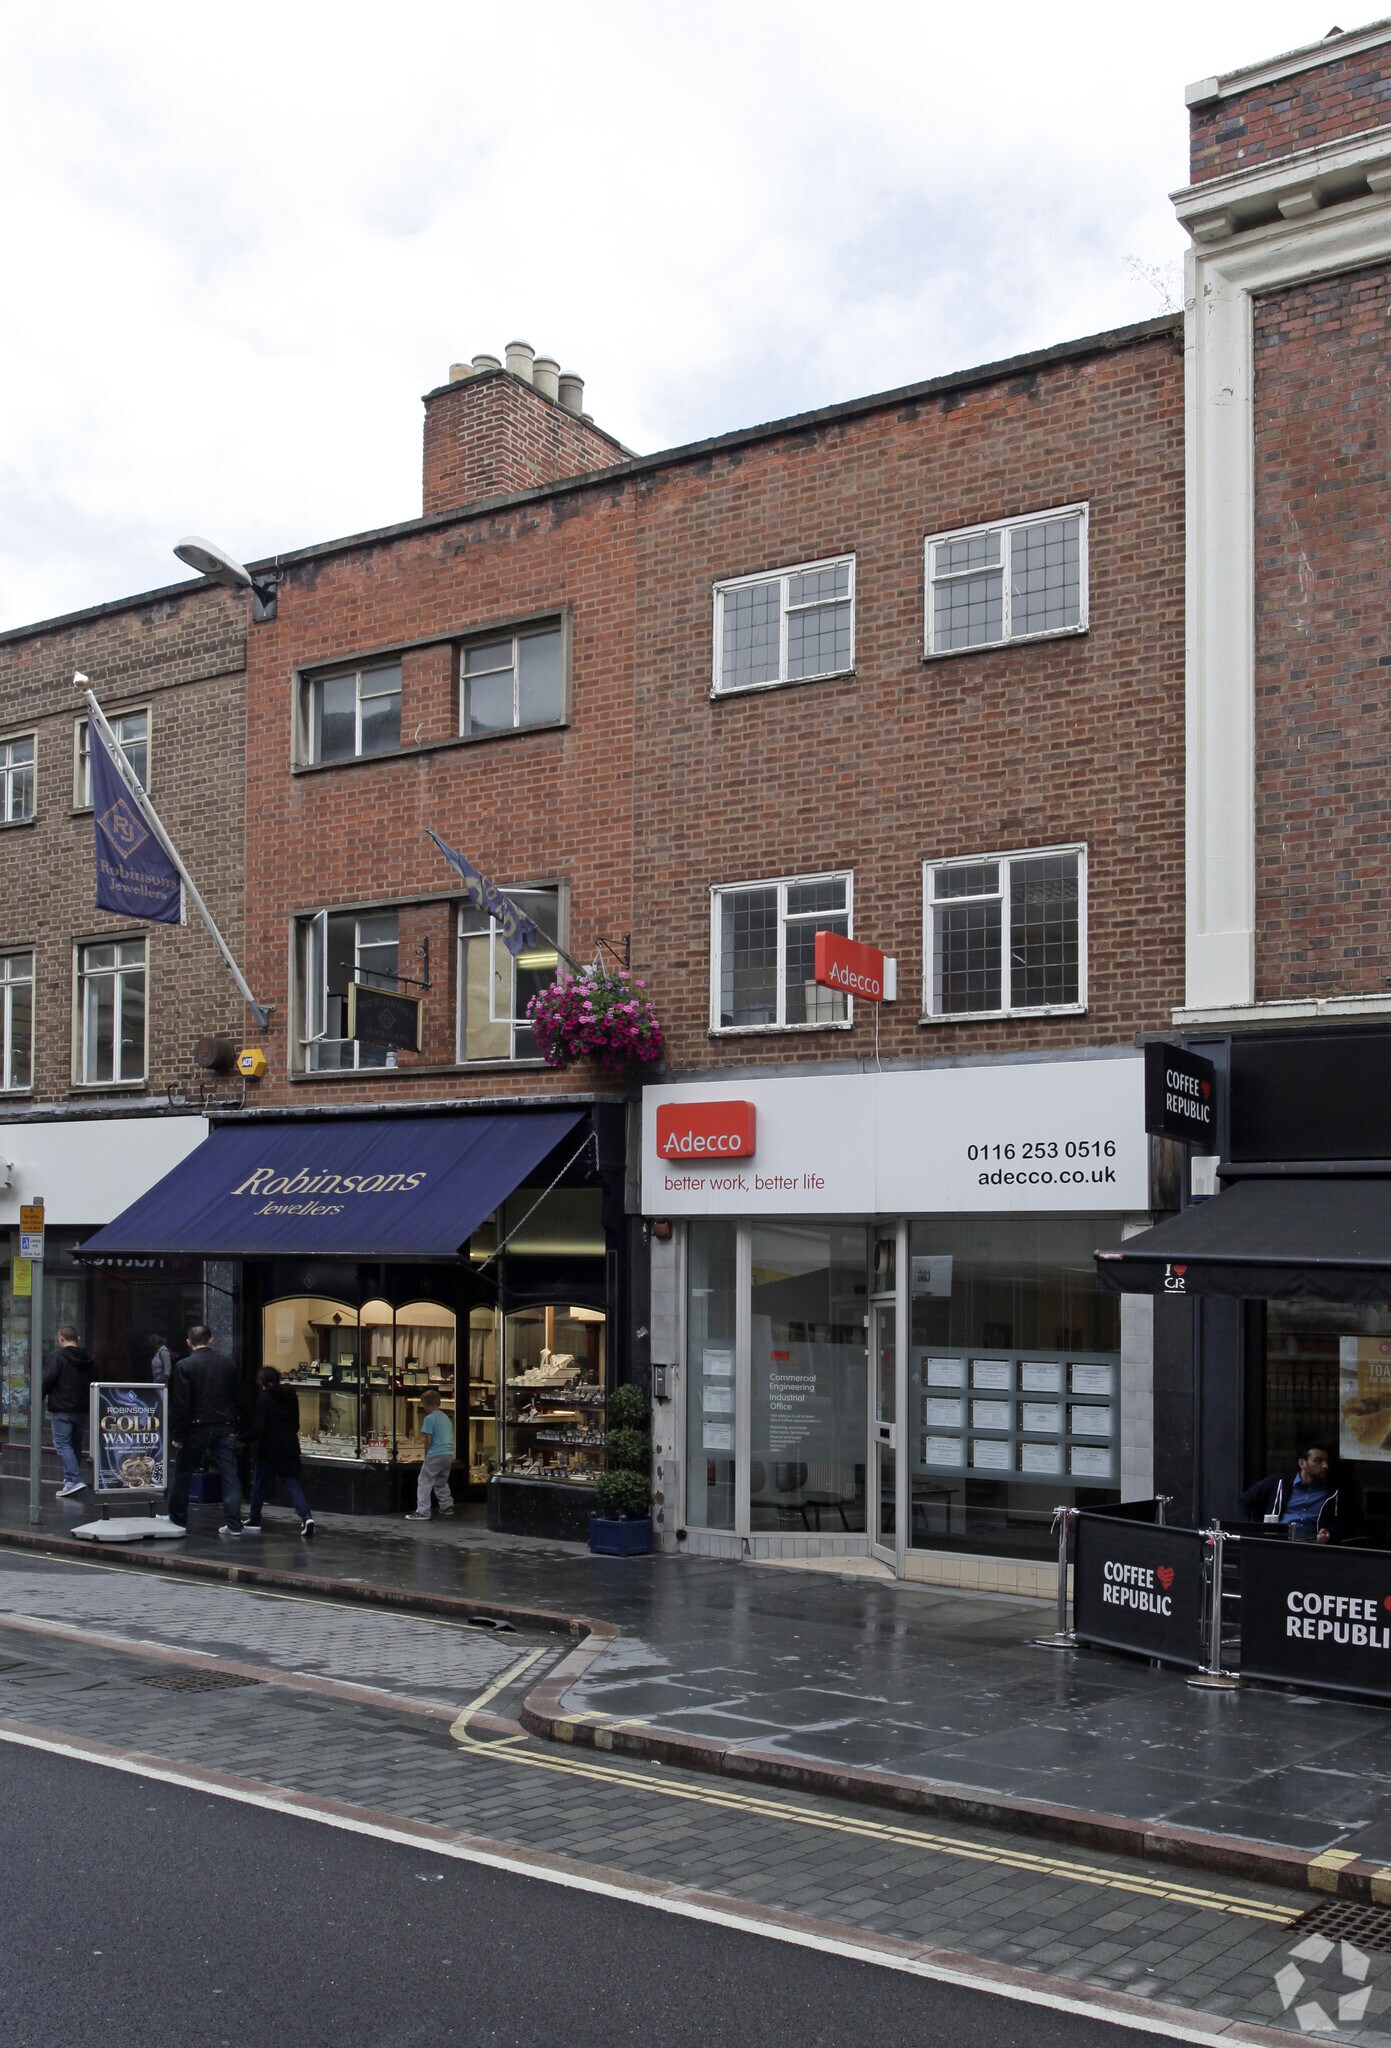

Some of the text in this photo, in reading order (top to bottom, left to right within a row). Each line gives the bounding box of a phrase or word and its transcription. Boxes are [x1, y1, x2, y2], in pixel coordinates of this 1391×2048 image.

[100, 859, 177, 889] Robinsons
[109, 878, 168, 900] Jewellers
[828, 961, 880, 995] Adecco
[242, 1058, 252, 1067] ADT
[1166, 1068, 1200, 1097] COFFEE
[1166, 1092, 1210, 1123] REPUBLIC
[663, 1130, 742, 1153] Adecco
[967, 1140, 1116, 1160] 0116 253 0516
[230, 1167, 427, 1195] Robinsons
[664, 1173, 825, 1192] better work, better life
[978, 1165, 1116, 1185] adecco.co.uk
[254, 1201, 345, 1216] Jewellers
[1164, 1263, 1172, 1276] I
[1164, 1277, 1185, 1289] CR
[769, 1373, 817, 1382] Commercial
[1369, 1364, 1391, 1377] TOA
[769, 1382, 815, 1393] Engineering
[769, 1394, 805, 1402] Industrial
[770, 1402, 793, 1410] Office
[100, 1415, 160, 1432] GOLD
[103, 1432, 159, 1444] WANTED
[1103, 1560, 1154, 1589] COFFEE
[1103, 1583, 1172, 1617] REPUBLIC
[1286, 1590, 1378, 1621] COFFEE
[1286, 1615, 1391, 1649] REPUBLI
